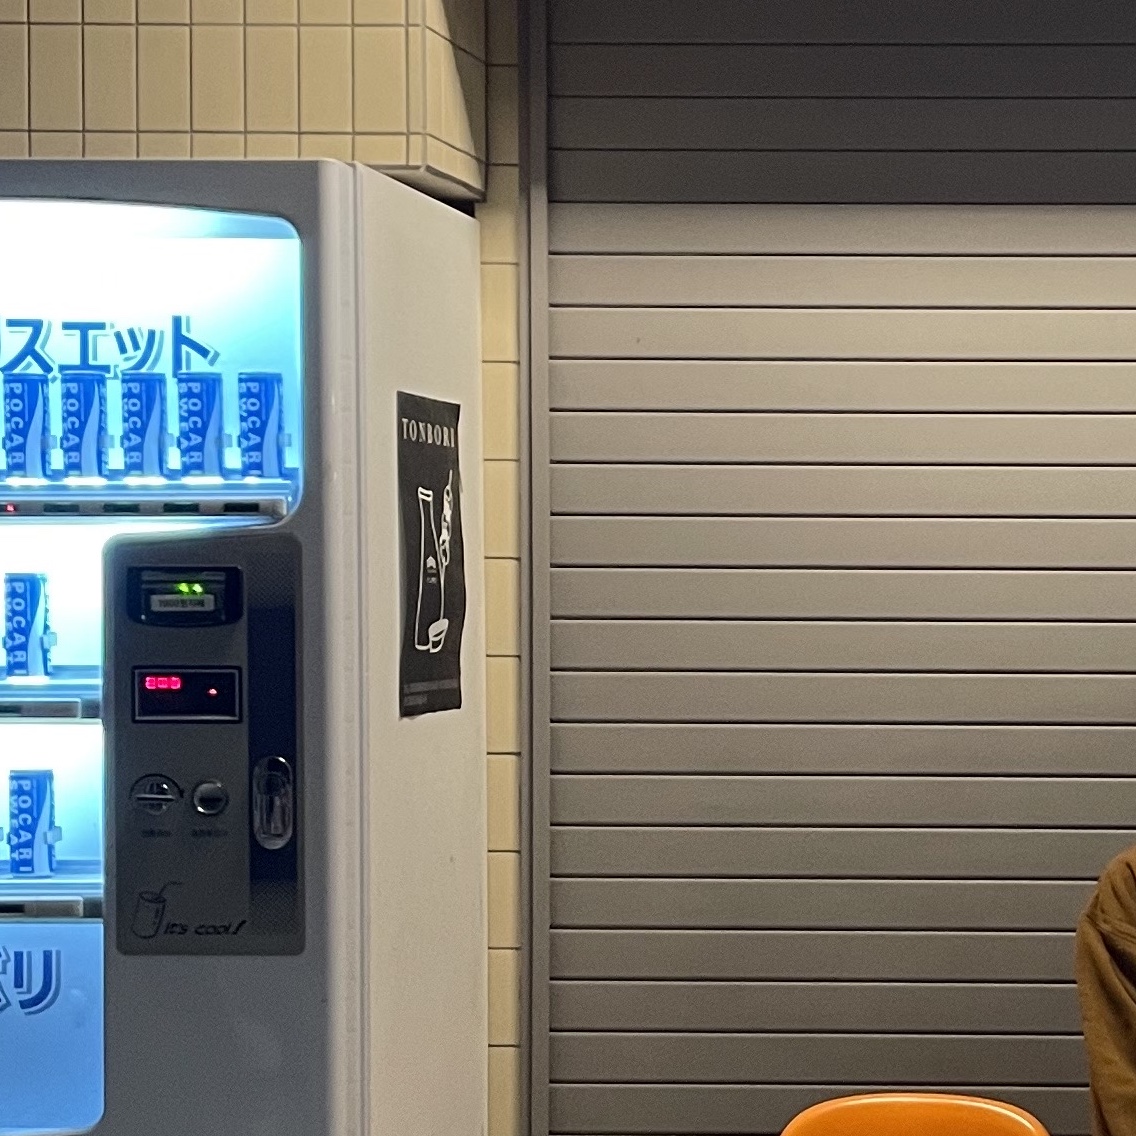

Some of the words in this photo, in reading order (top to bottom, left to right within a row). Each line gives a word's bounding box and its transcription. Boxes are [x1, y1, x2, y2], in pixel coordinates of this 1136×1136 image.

[0, 315, 217, 379] スエット
[9, 382, 25, 475] POCARI
[66, 382, 80, 475] POCARI
[126, 382, 142, 475] POCARI
[187, 382, 202, 475] POCARI
[246, 382, 261, 475] POCARI
[401, 417, 455, 448] TONBORI
[12, 581, 27, 675] POCARI
[18, 780, 32, 872] POCARI
[0, 946, 61, 1016] リ
